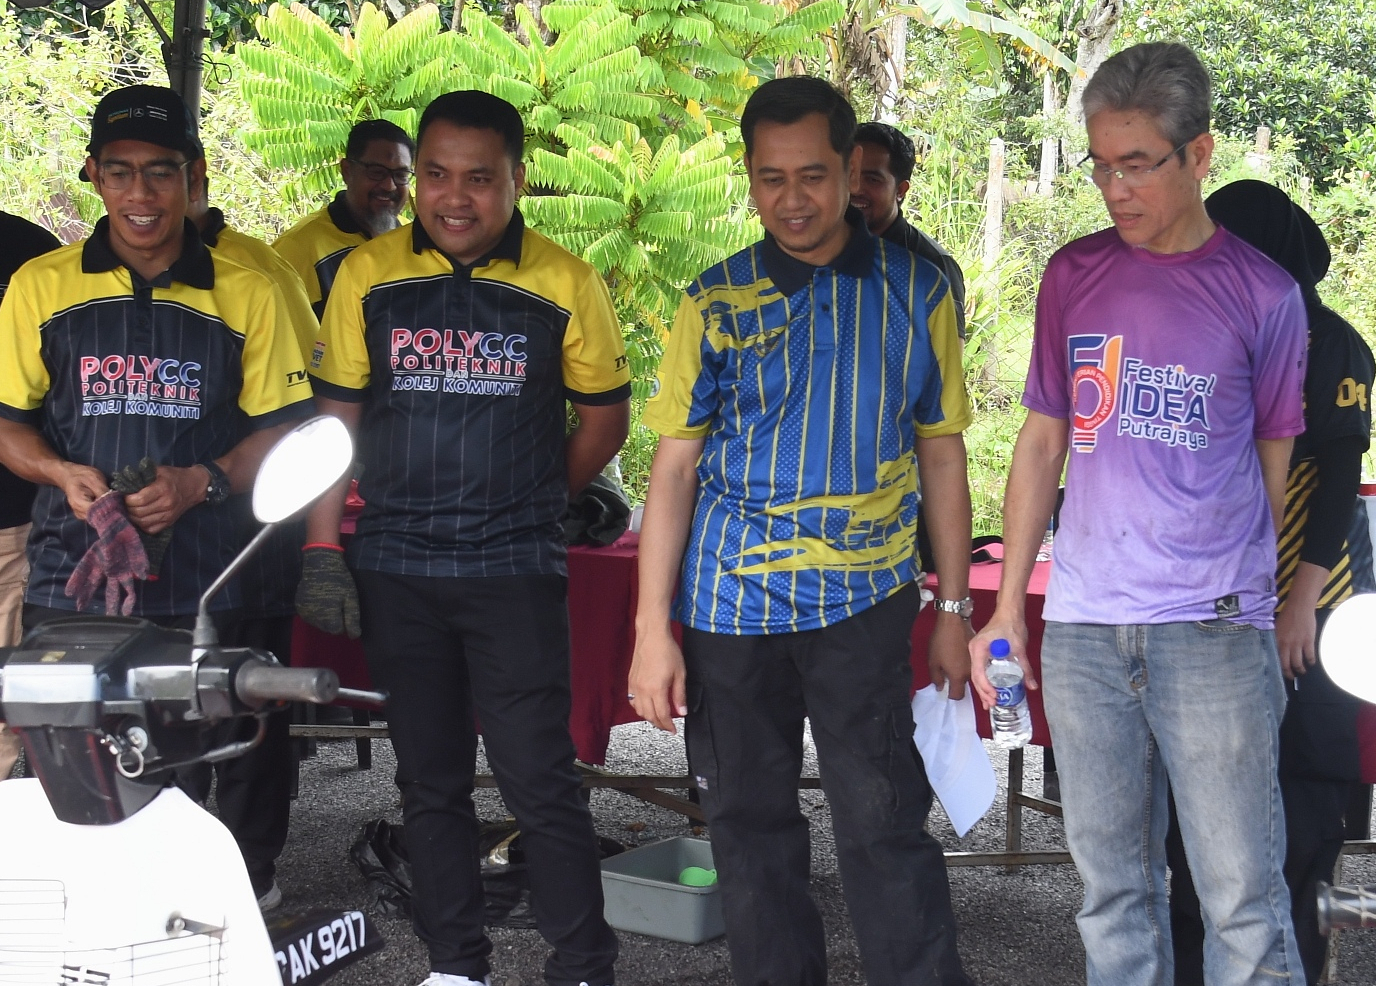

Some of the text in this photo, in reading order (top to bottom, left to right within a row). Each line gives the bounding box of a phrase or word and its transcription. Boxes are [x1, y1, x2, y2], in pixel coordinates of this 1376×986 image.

[390, 328, 527, 361] POLYCC
[80, 355, 201, 387] POLYCC
[390, 354, 526, 376] POLITEKNIK
[445, 369, 468, 379] DAN
[286, 369, 310, 387] TV
[392, 376, 523, 396] KOLEJ KOMUNIT
[1124, 357, 1216, 397] Festival
[81, 380, 200, 401] POLITEKNIK
[127, 393, 148, 401] DAN
[82, 399, 200, 419] KOLEJ KOMUNITI
[1119, 380, 1211, 430] IDEA
[1117, 418, 1208, 451] Putrajaya
[317, 911, 365, 965] 9217
